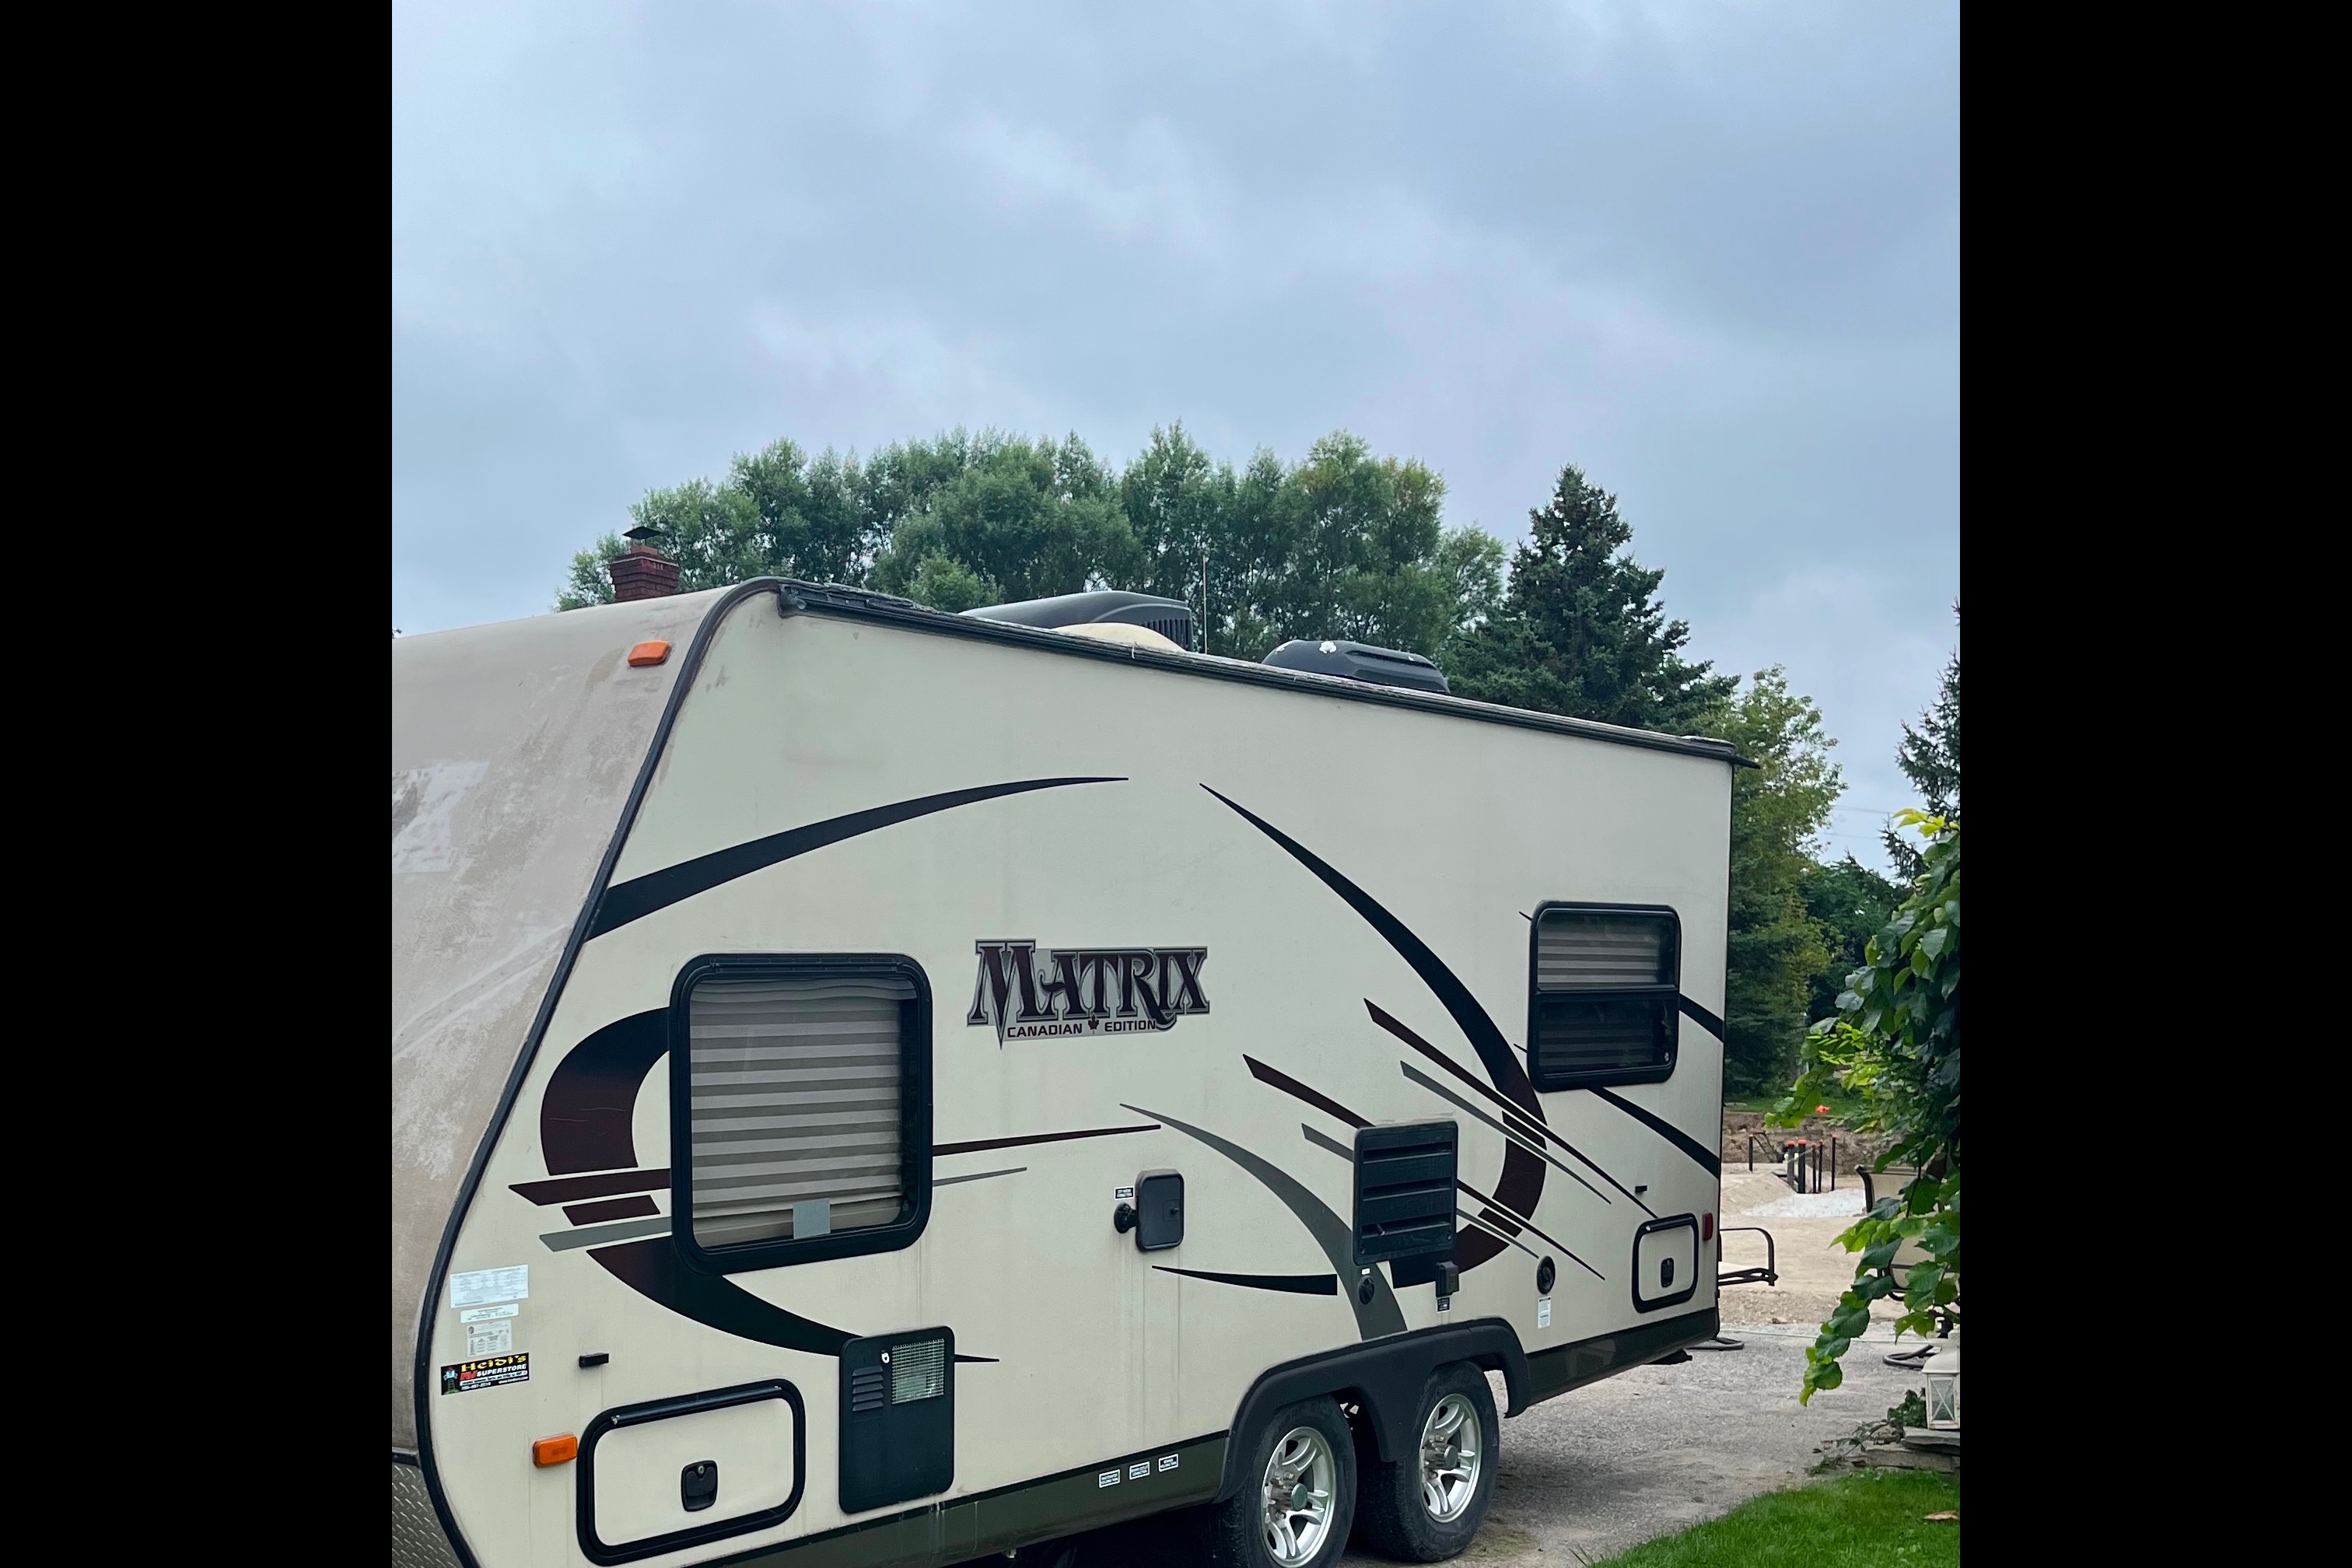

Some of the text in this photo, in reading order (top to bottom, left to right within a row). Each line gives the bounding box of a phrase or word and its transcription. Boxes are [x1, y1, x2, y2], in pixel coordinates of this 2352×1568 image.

[967, 939, 1210, 1049] MATRIX
[1007, 1020, 1156, 1038] CANADIAN EDITION
[477, 1363, 527, 1377] SUPERSTORE
